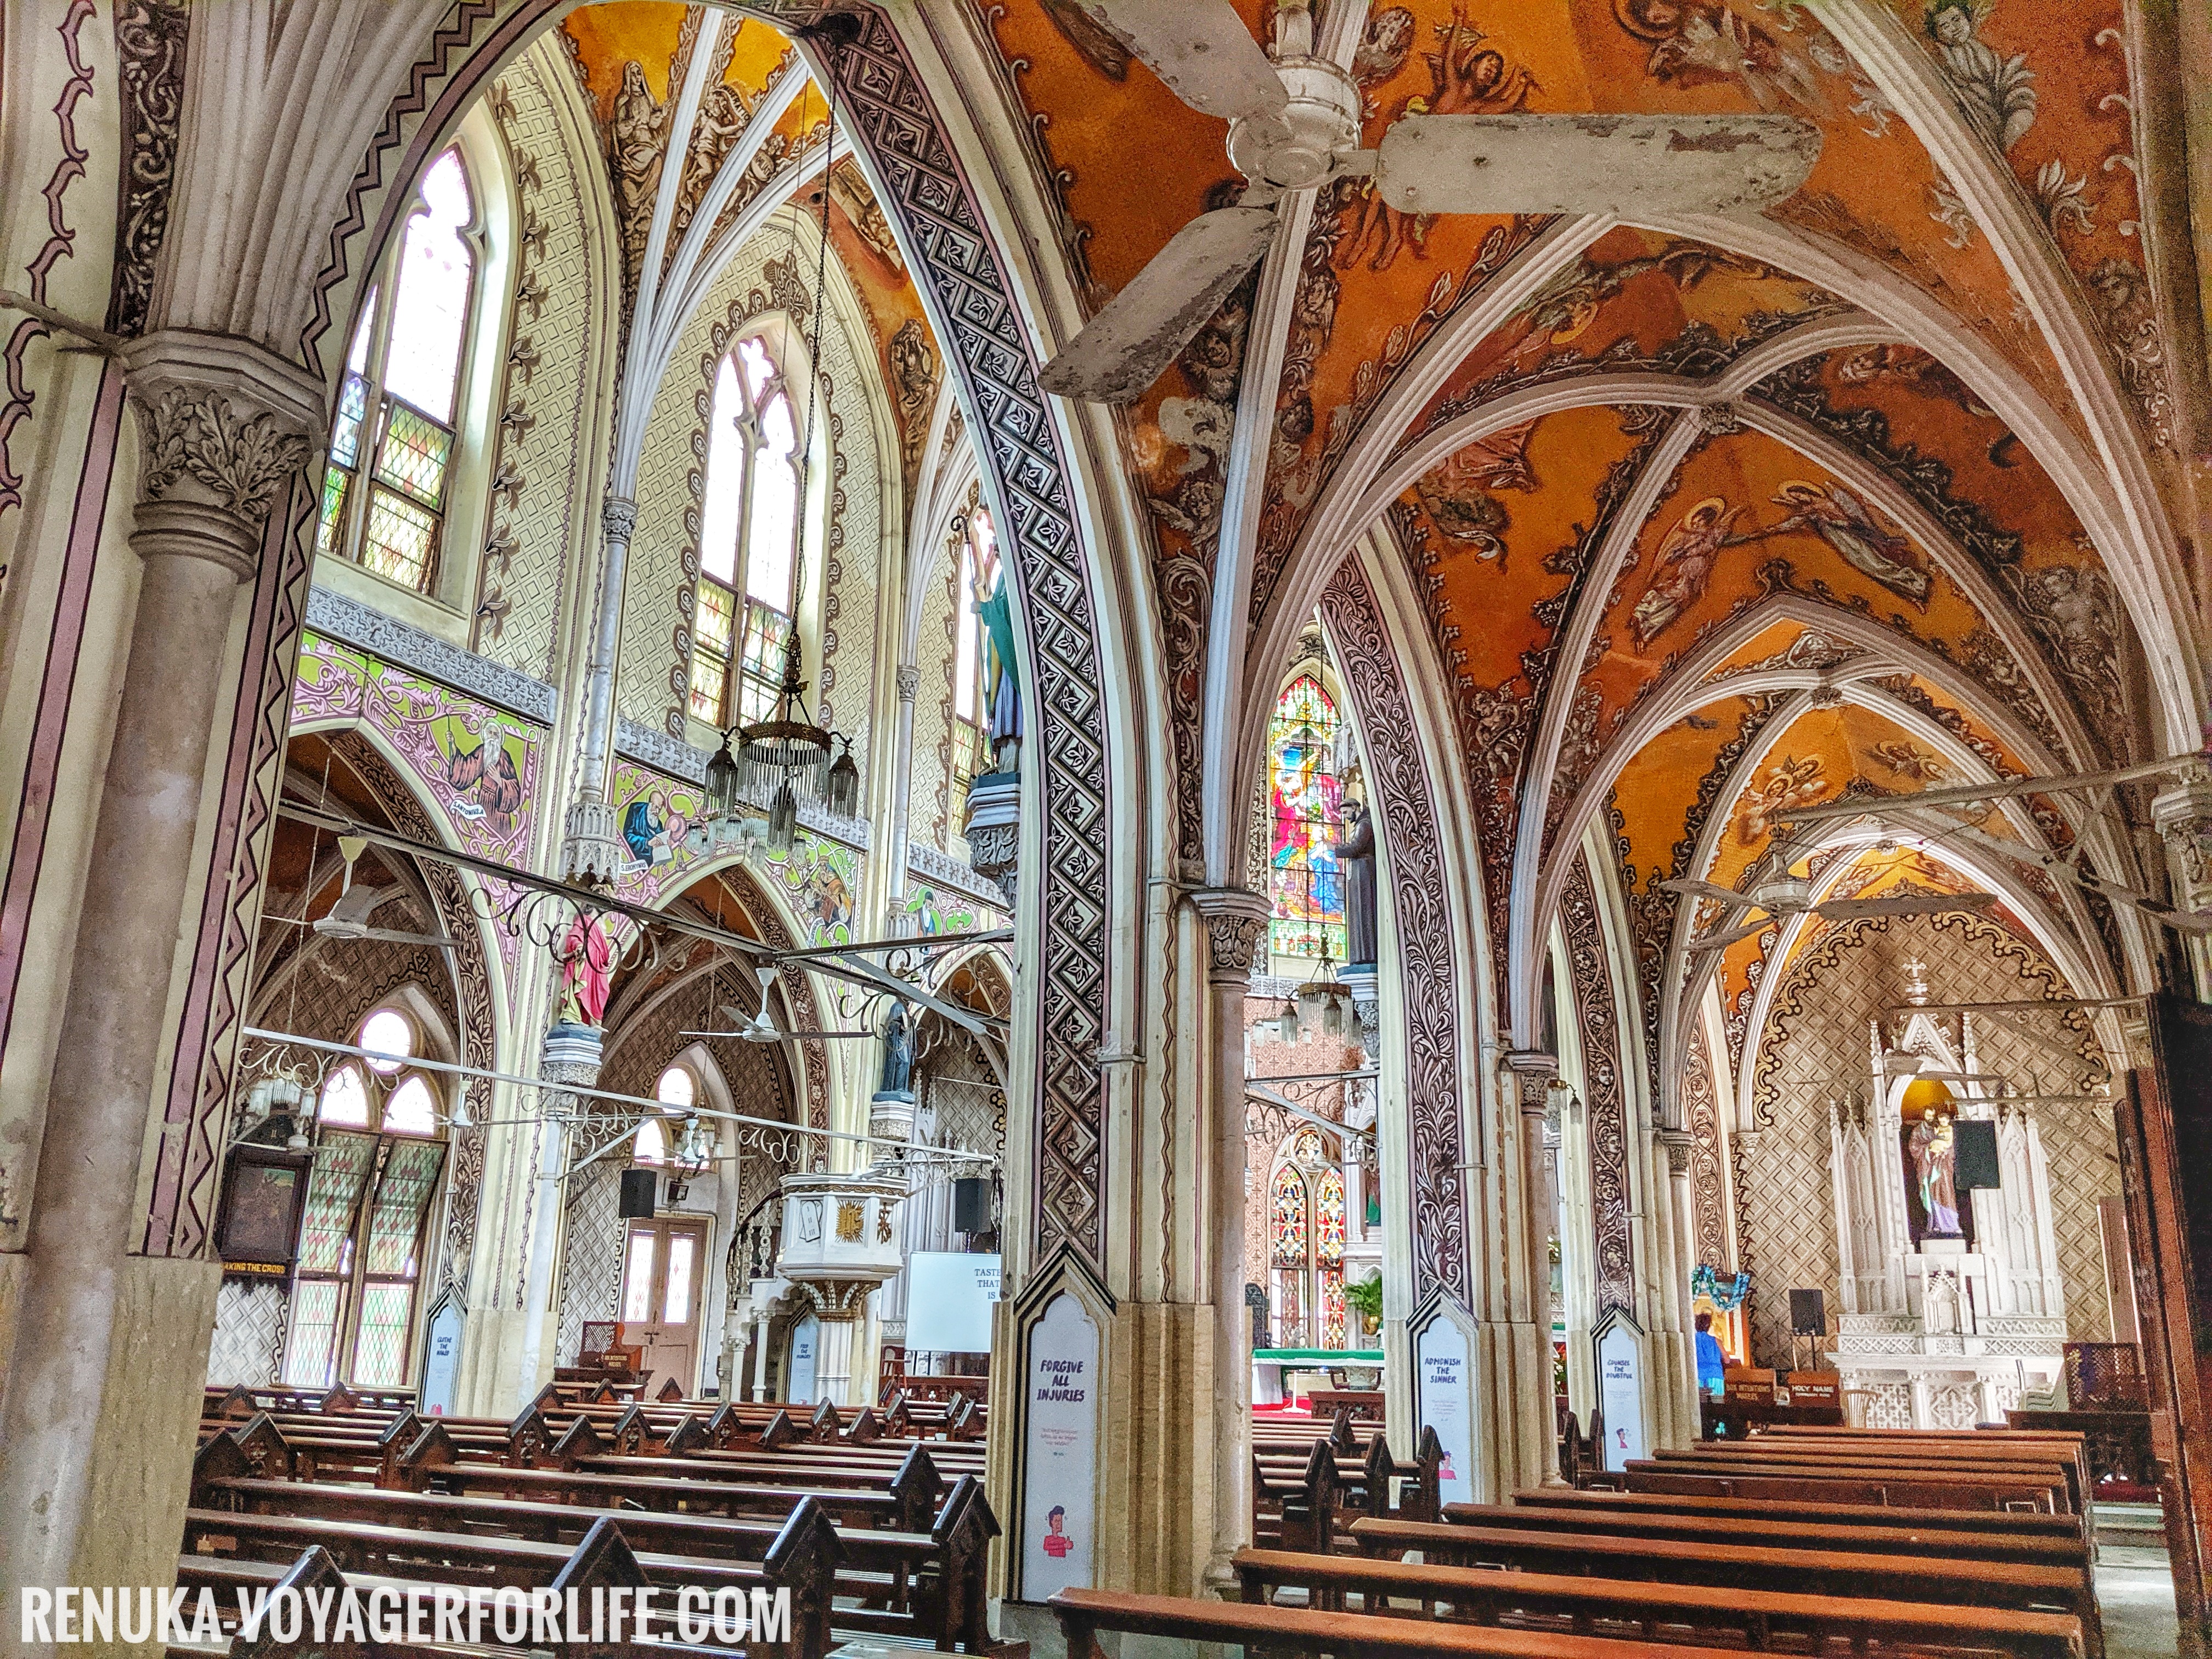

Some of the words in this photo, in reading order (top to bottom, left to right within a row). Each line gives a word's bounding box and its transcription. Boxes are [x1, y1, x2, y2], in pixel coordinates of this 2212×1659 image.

[247, 1263, 262, 1272] THE
[262, 1264, 285, 1274] CROSS
[1041, 1359, 1084, 1373] FORGIVE
[1425, 1357, 1461, 1366] ADMONISH
[1052, 1374, 1069, 1387] ALL
[1430, 1375, 1457, 1384] SINNER
[1037, 1388, 1085, 1402] INJURIES
